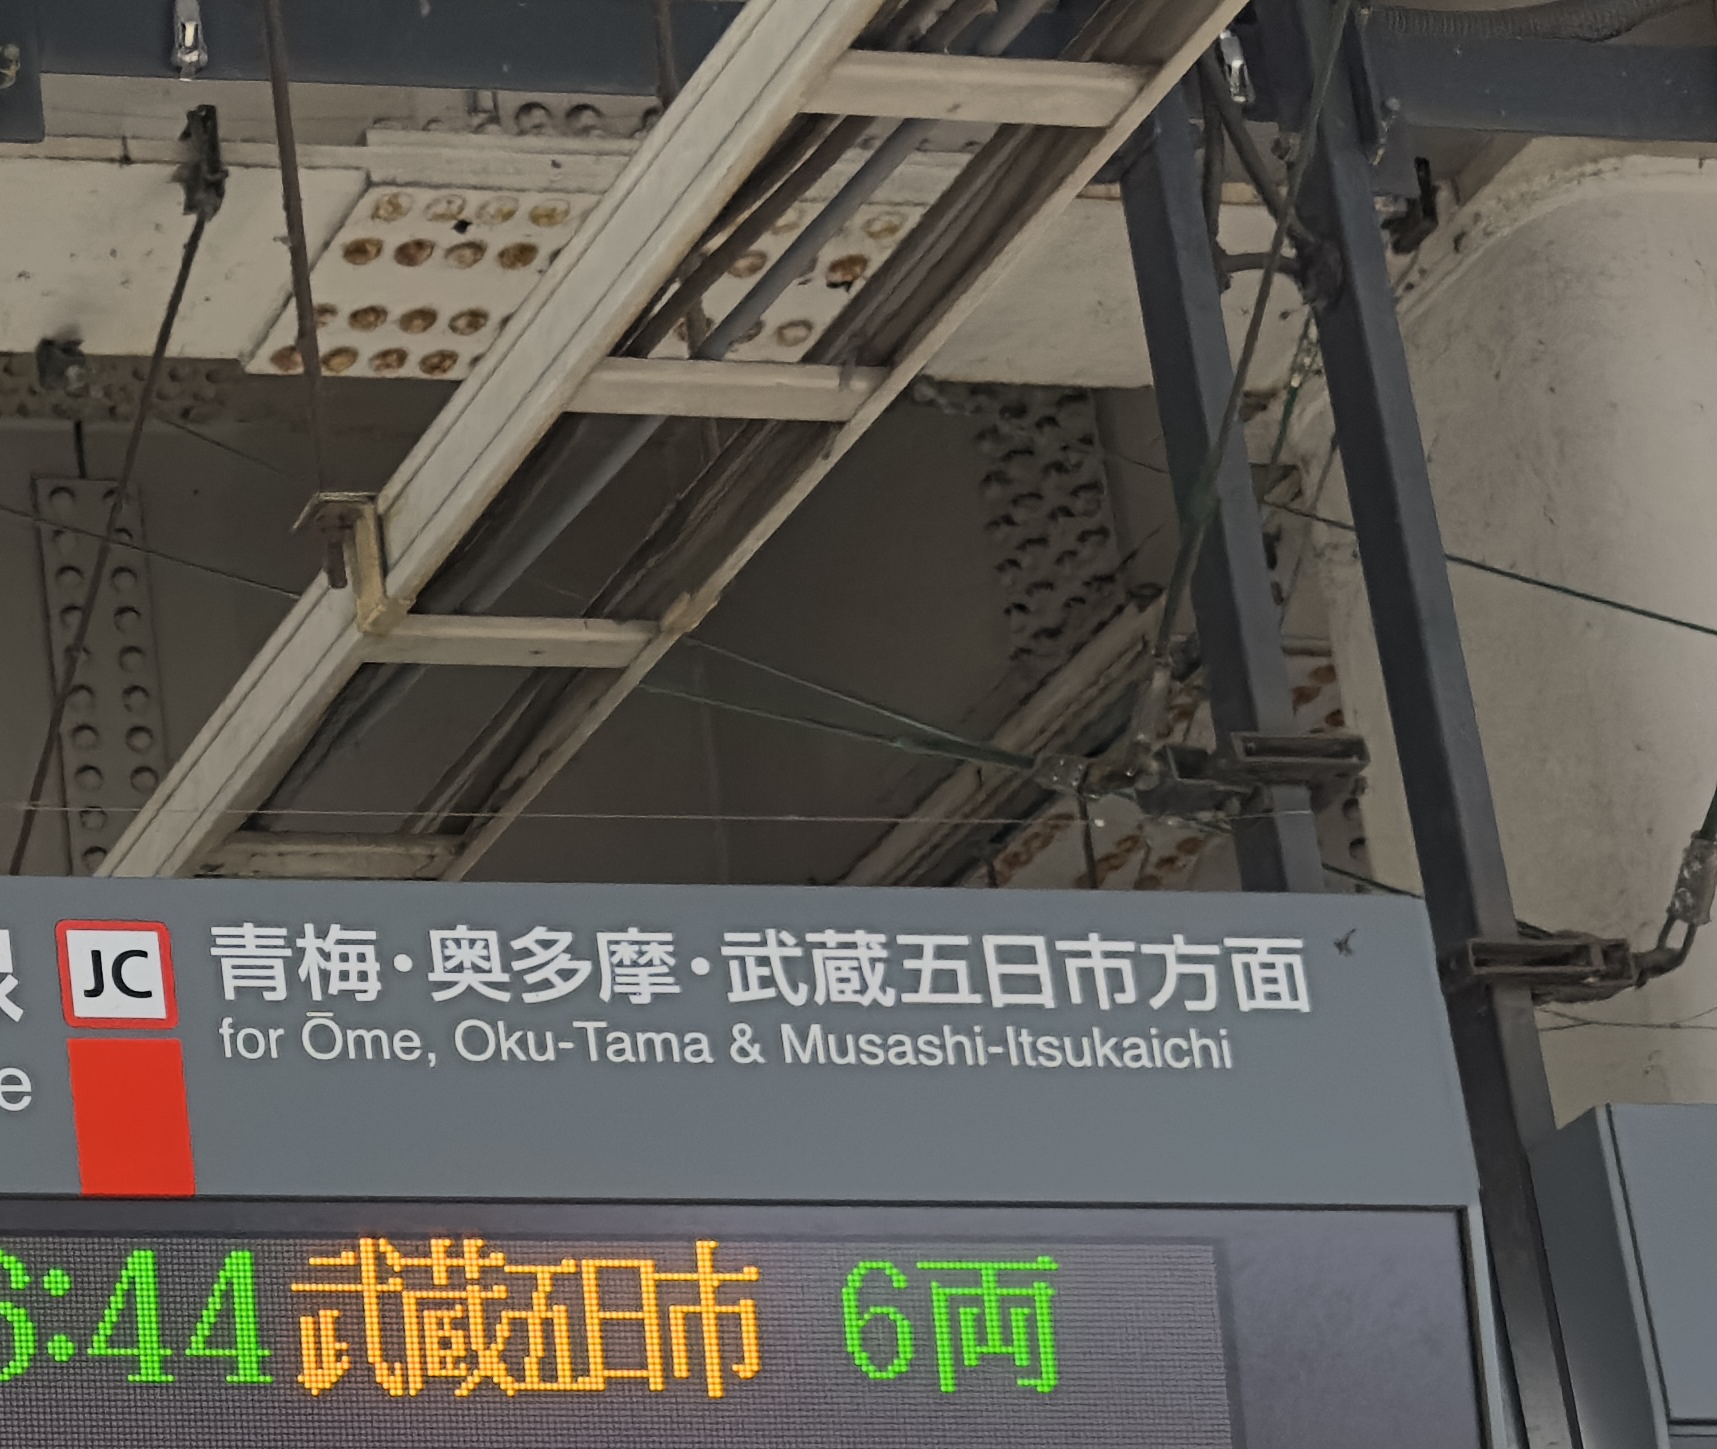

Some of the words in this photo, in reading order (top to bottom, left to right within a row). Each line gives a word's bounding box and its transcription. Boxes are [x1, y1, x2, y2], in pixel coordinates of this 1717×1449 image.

[82, 946, 153, 1001] JC
[208, 921, 1310, 1015] 青梅・奥多摩・武蔵五日市方面
[218, 1016, 286, 1061] for
[453, 1019, 714, 1065] Oku-Tama
[728, 1023, 766, 1066] &
[780, 1023, 1235, 1072] Musashi-Itsukaichi
[291, 1238, 760, 1397] 武蔵五日市
[842, 1255, 1059, 1392] 6両
